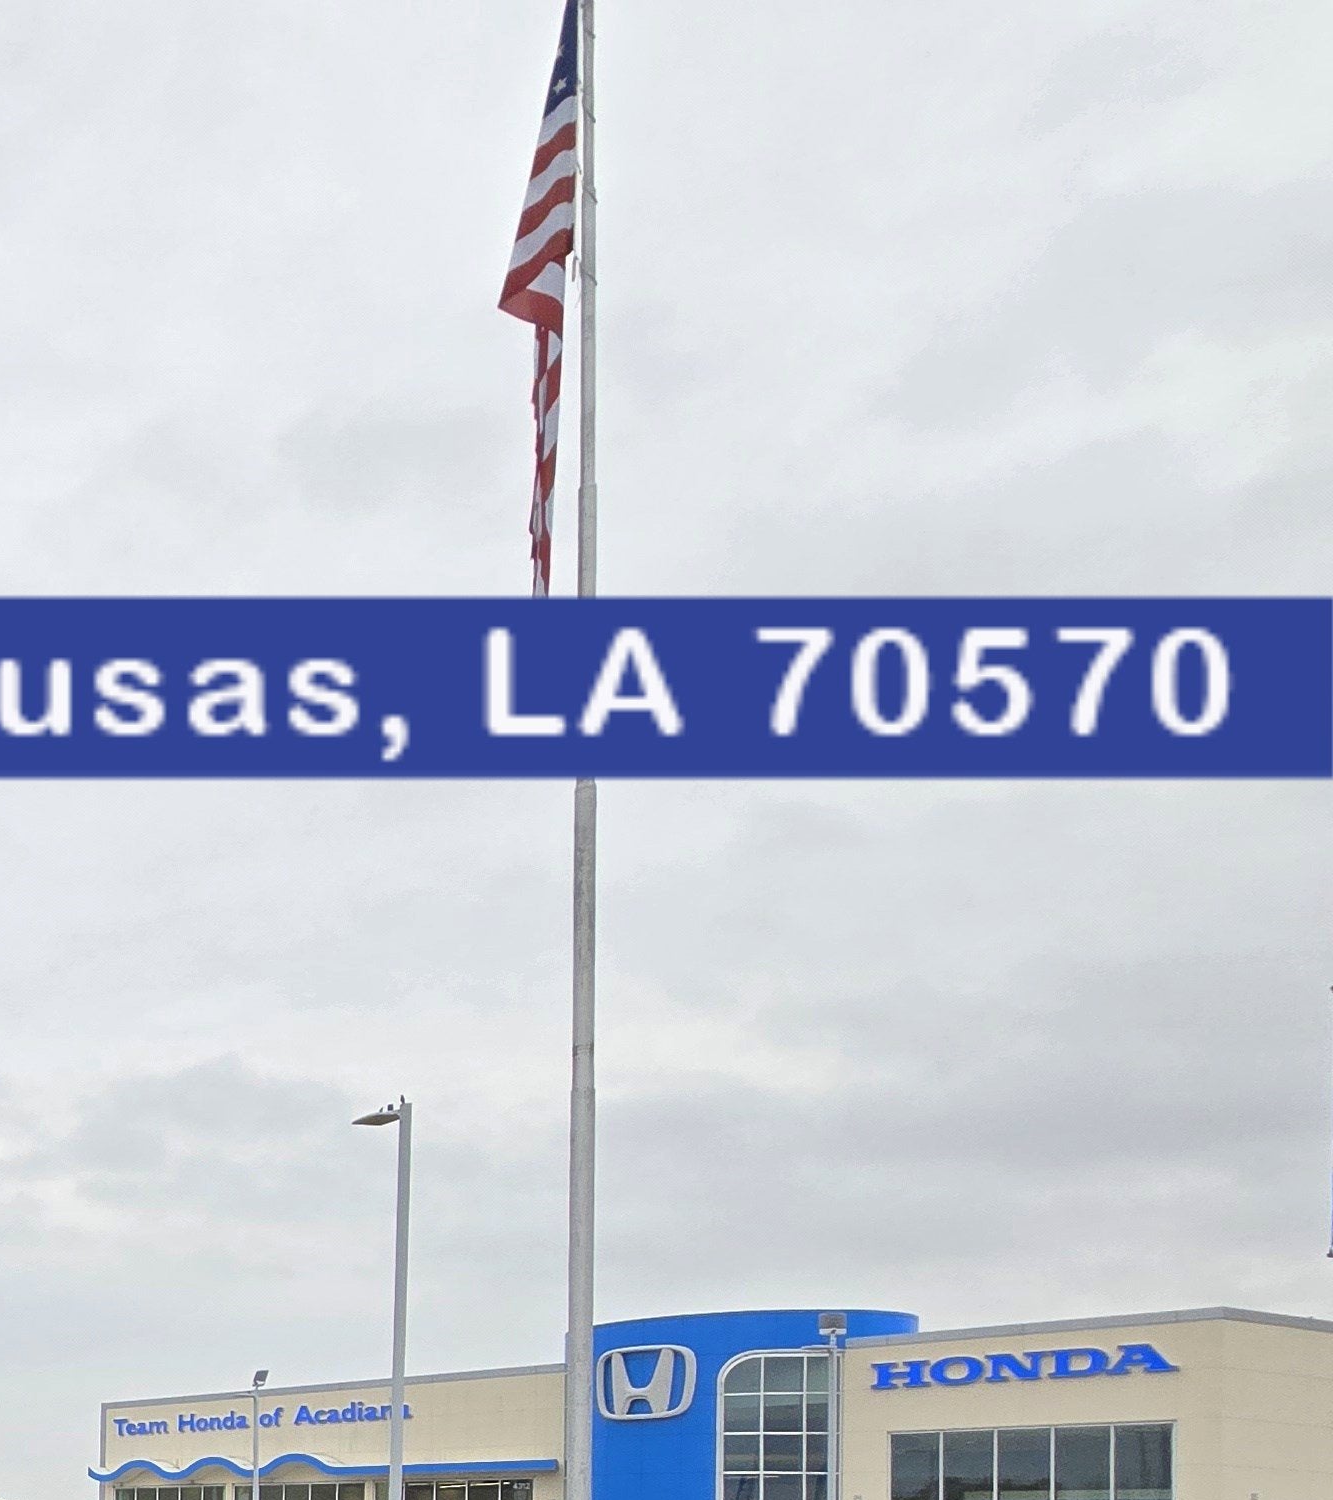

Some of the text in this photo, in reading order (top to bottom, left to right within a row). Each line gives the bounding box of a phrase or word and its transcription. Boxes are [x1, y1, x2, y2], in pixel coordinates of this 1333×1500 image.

[871, 1343, 1179, 1391] HONDA
[113, 1418, 168, 1437] Team
[178, 1411, 250, 1432] Honda
[259, 1407, 284, 1427] of
